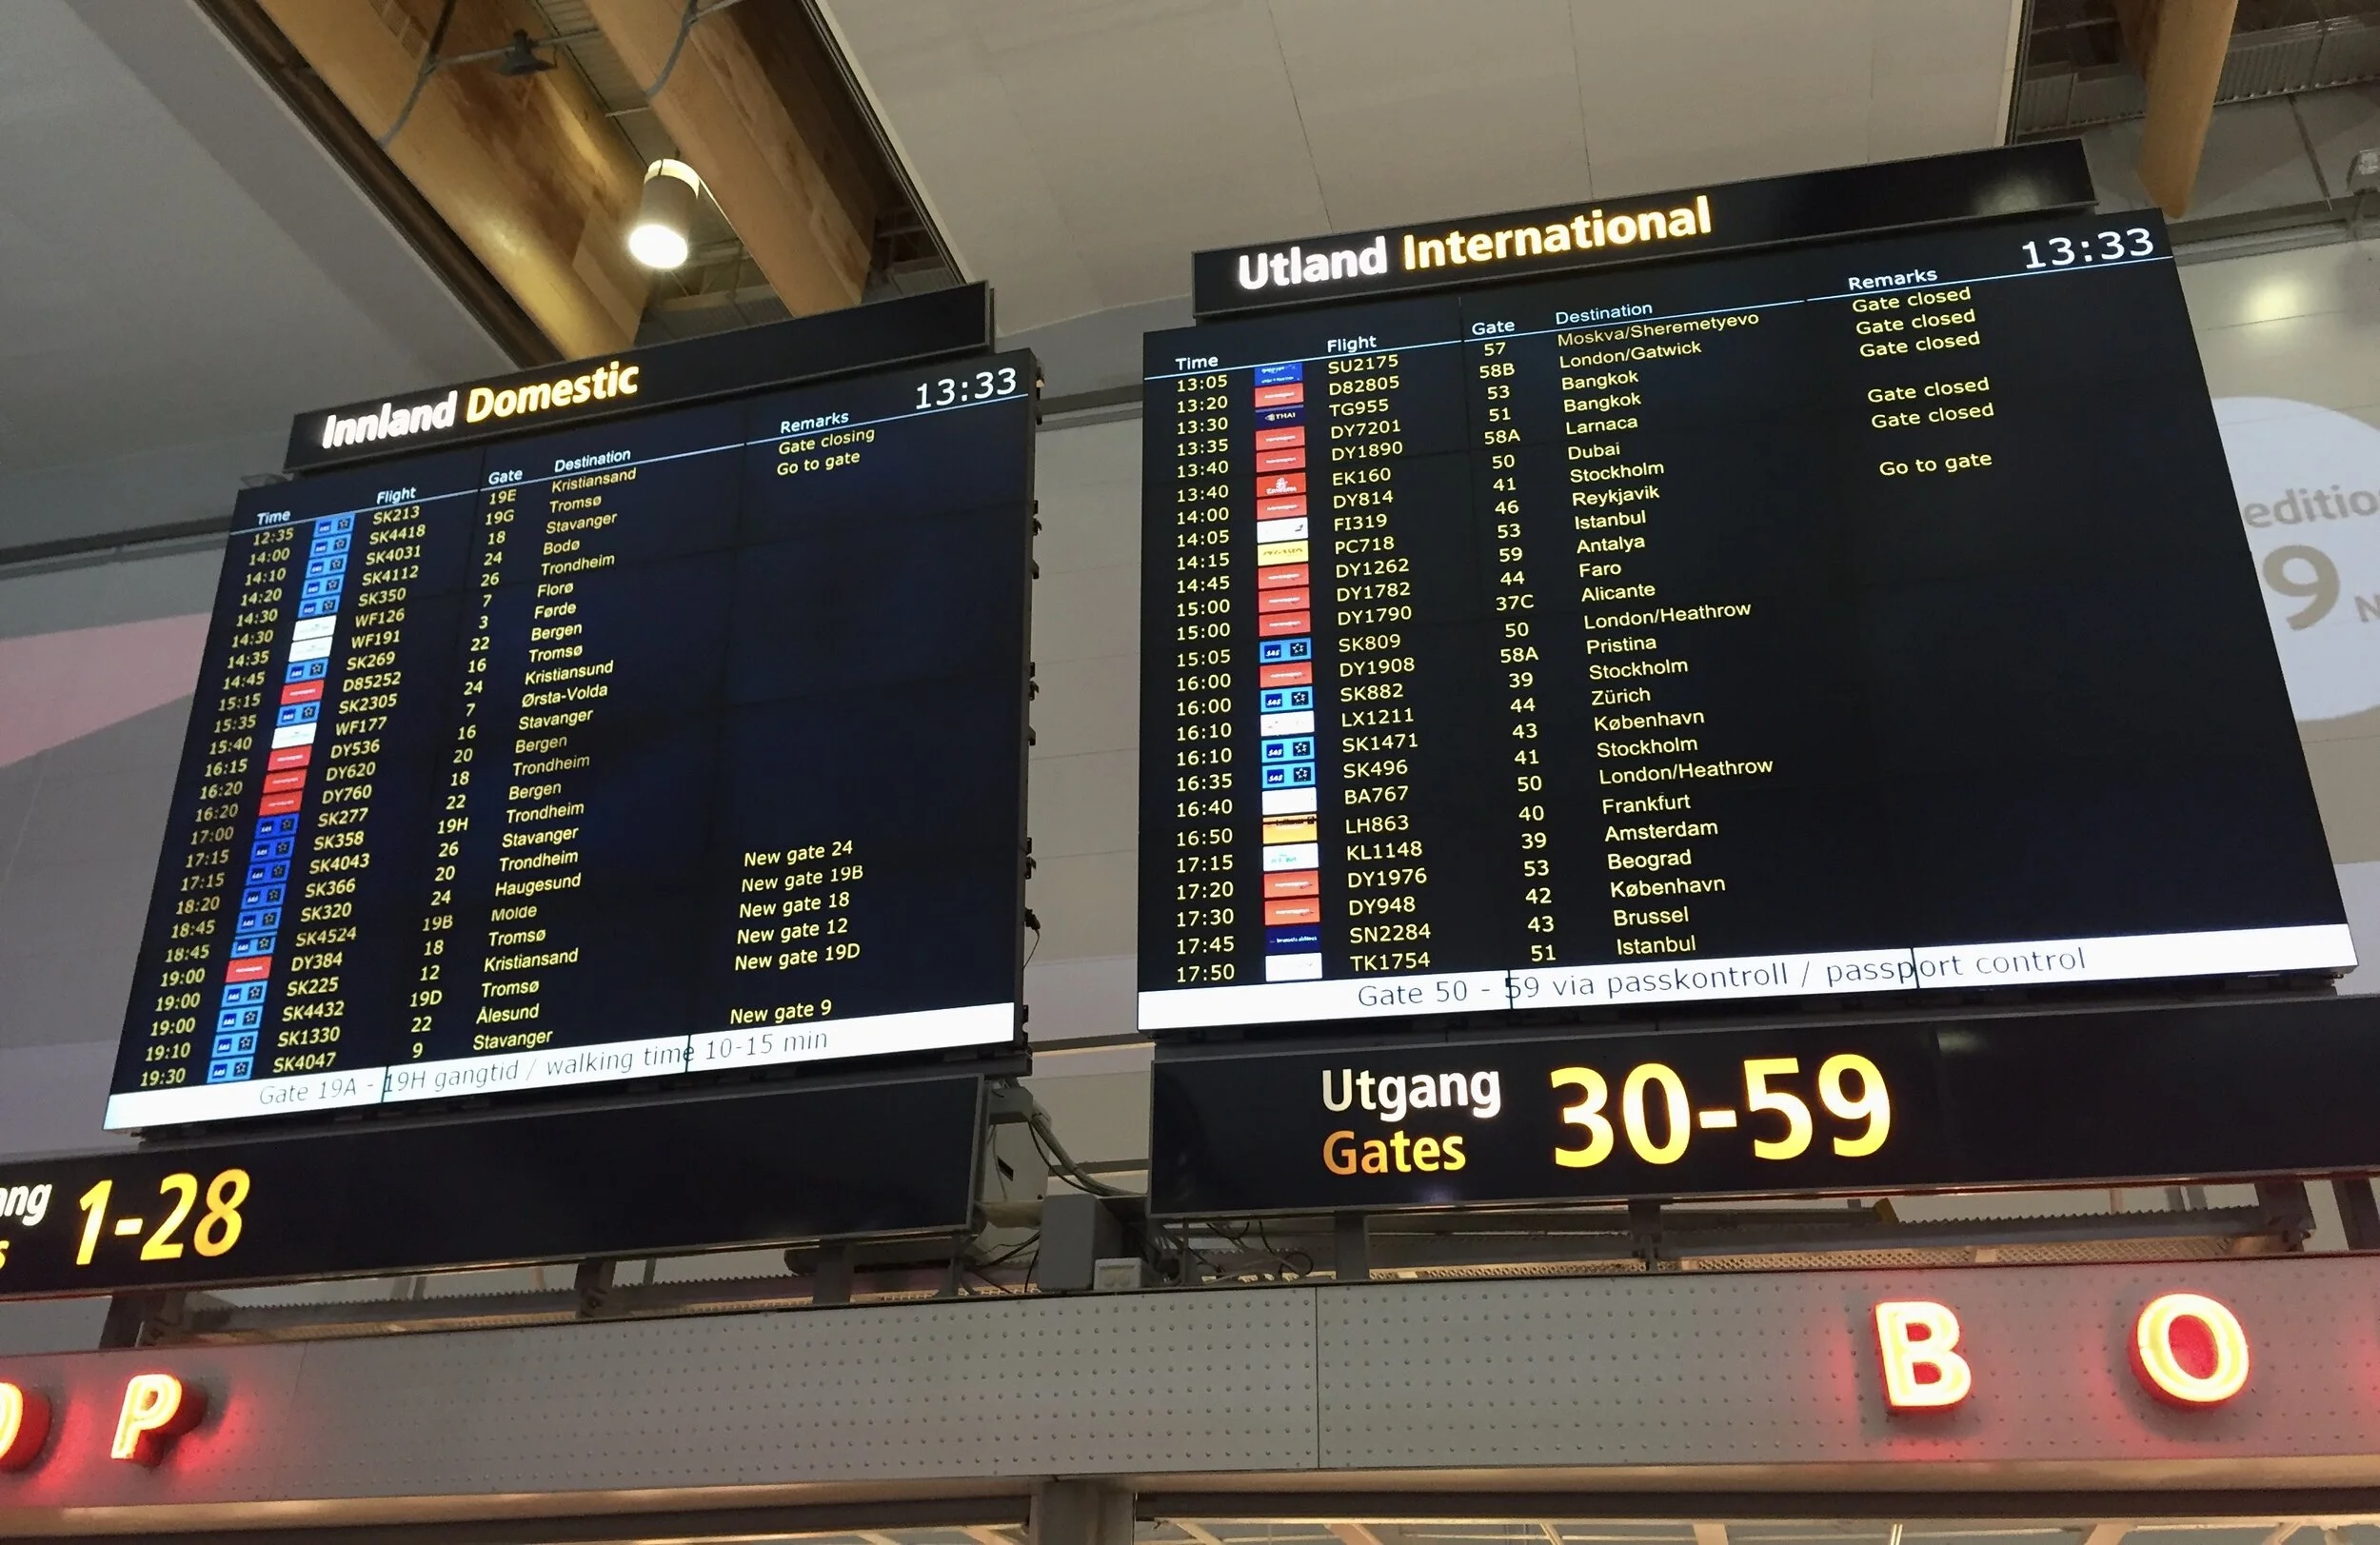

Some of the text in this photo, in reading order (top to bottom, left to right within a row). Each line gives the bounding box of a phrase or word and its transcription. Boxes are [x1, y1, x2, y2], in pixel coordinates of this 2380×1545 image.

[1238, 195, 1713, 290] Utland International
[2022, 228, 2153, 268] 13:33
[1175, 268, 1937, 369] Time Flight Gate Destination Remarks
[1177, 286, 1972, 393] 13:05 SU2175 57 Moskva/Sheremetyevo Gate closed
[322, 362, 639, 448] Innland Domestic
[916, 367, 1017, 409] 13:33
[1177, 416, 1229, 435] 13:30
[1330, 398, 1389, 416] TG955
[1487, 385, 1511, 401] 53
[1561, 370, 1639, 391] Bangkok
[1859, 341, 1909, 358] Gate
[1914, 330, 1981, 351] closed
[1177, 376, 1991, 479] 13:40 DY1890 58A Larnaca Gate closed
[254, 429, 875, 545] 12:35 SK213 19E Kristiansand Gate closing
[256, 412, 849, 525] Time Flight Gate Destination Remarks
[1177, 452, 1993, 548] 14:05 FI319 46 Reykjavik Go to gate
[250, 451, 861, 565] 14:00 SK4418 19G Tromsø Go to gate
[2244, 484, 2380, 528] editio
[237, 554, 615, 627] 14:30 SK350 26 Trondheim
[1177, 535, 1646, 594] 14:45 DY1262 59 Antalya
[2263, 545, 2340, 631] 9
[1177, 583, 1656, 642] 15:00 DY1790 37C Alicante
[1177, 648, 1231, 668] 15:05
[1338, 633, 1401, 653] SK809
[1505, 622, 1530, 639] 50
[1583, 604, 1752, 630] London/Heathrow
[215, 661, 614, 733] 15:35 SK2305 24 Kristiansund
[1177, 687, 1652, 742] 16:10 LX1211 44 Zürich
[1177, 772, 1233, 792] 16:35
[1343, 759, 1409, 780] SK496
[1514, 748, 1539, 765] 41
[1597, 738, 1698, 759] Stockholm
[192, 782, 562, 845] 17:00 SK277 22 Bergen
[1177, 794, 1692, 847] 16:50 LH863 40 Frankfurt
[176, 851, 579, 915] 18:20 SK366 20 Trondheim
[1177, 848, 1693, 901] 17:20 DY1976 53 Beograd
[167, 864, 863, 962] 18:45 SK4524 19B Molde New gate 19B
[1177, 906, 1690, 956] 17:45 SN2284 43 Brussel
[151, 942, 861, 1037] 19:00 SK4432 19D Tromsø New gate 19D
[1358, 983, 1423, 1007] Gate
[1436, 980, 1468, 1002] 50
[1506, 976, 1539, 1000] 59
[1552, 975, 1594, 998] via
[1608, 961, 1788, 1000] passkontroll
[1801, 961, 1810, 988] /
[1827, 955, 1964, 987] passport
[1975, 947, 2086, 975] control
[141, 999, 832, 1087] 19:30 SK4047 9 Stavanger New gate 9
[260, 1083, 308, 1106] Gate
[319, 1078, 357, 1099] 19A
[384, 1070, 425, 1094] 19H
[434, 1062, 519, 1092] gangtid
[526, 1059, 534, 1080] /
[547, 1049, 634, 1076] walking
[645, 1044, 695, 1066] time
[706, 1033, 774, 1061] 10-15
[783, 1030, 828, 1052] min
[1321, 1068, 1500, 1123] Utgang
[1550, 1053, 1892, 1168] 30-59
[1322, 1130, 1466, 1176] Gates
[75, 1168, 250, 1265] 1-28
